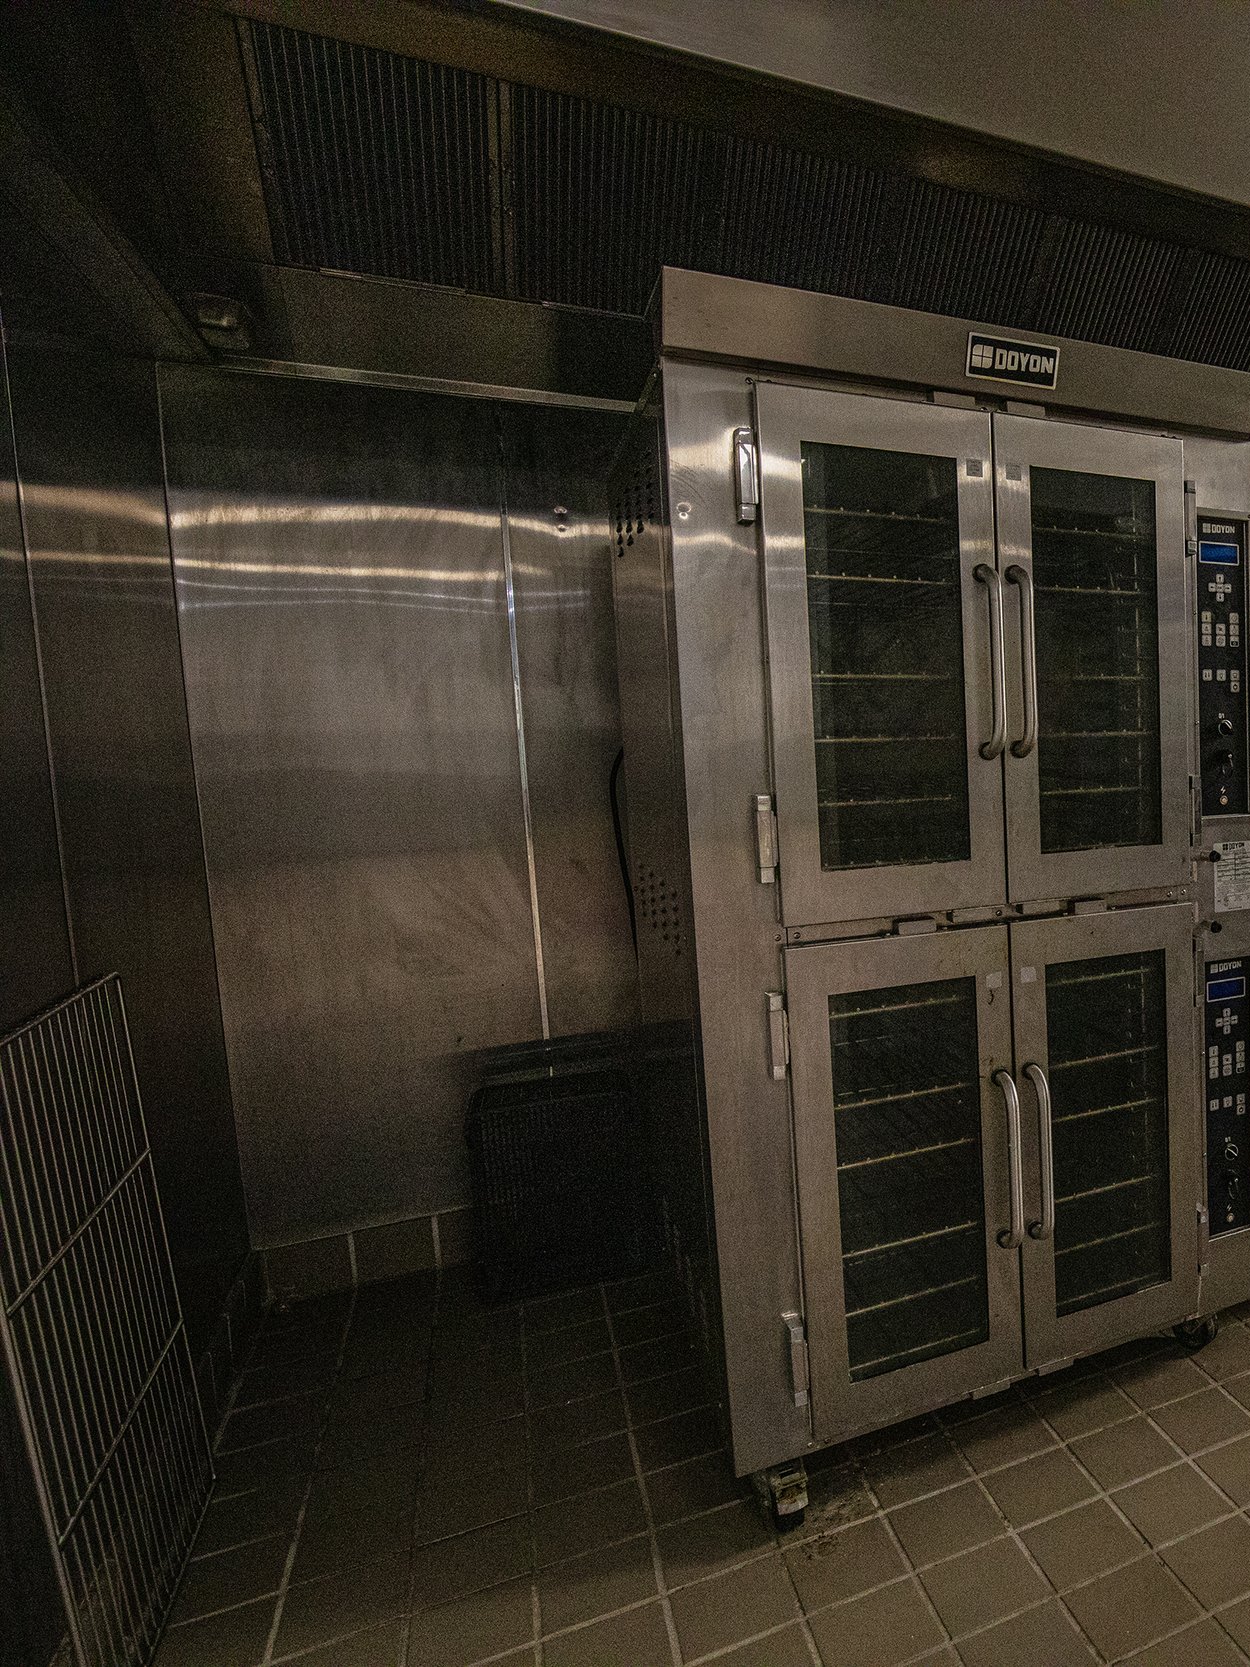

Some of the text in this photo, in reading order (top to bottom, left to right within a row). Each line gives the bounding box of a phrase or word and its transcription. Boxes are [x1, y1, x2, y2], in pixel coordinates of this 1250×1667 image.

[994, 348, 1054, 374] DOYON
[1211, 524, 1235, 534] DOYON
[1218, 960, 1242, 972] DOYON
